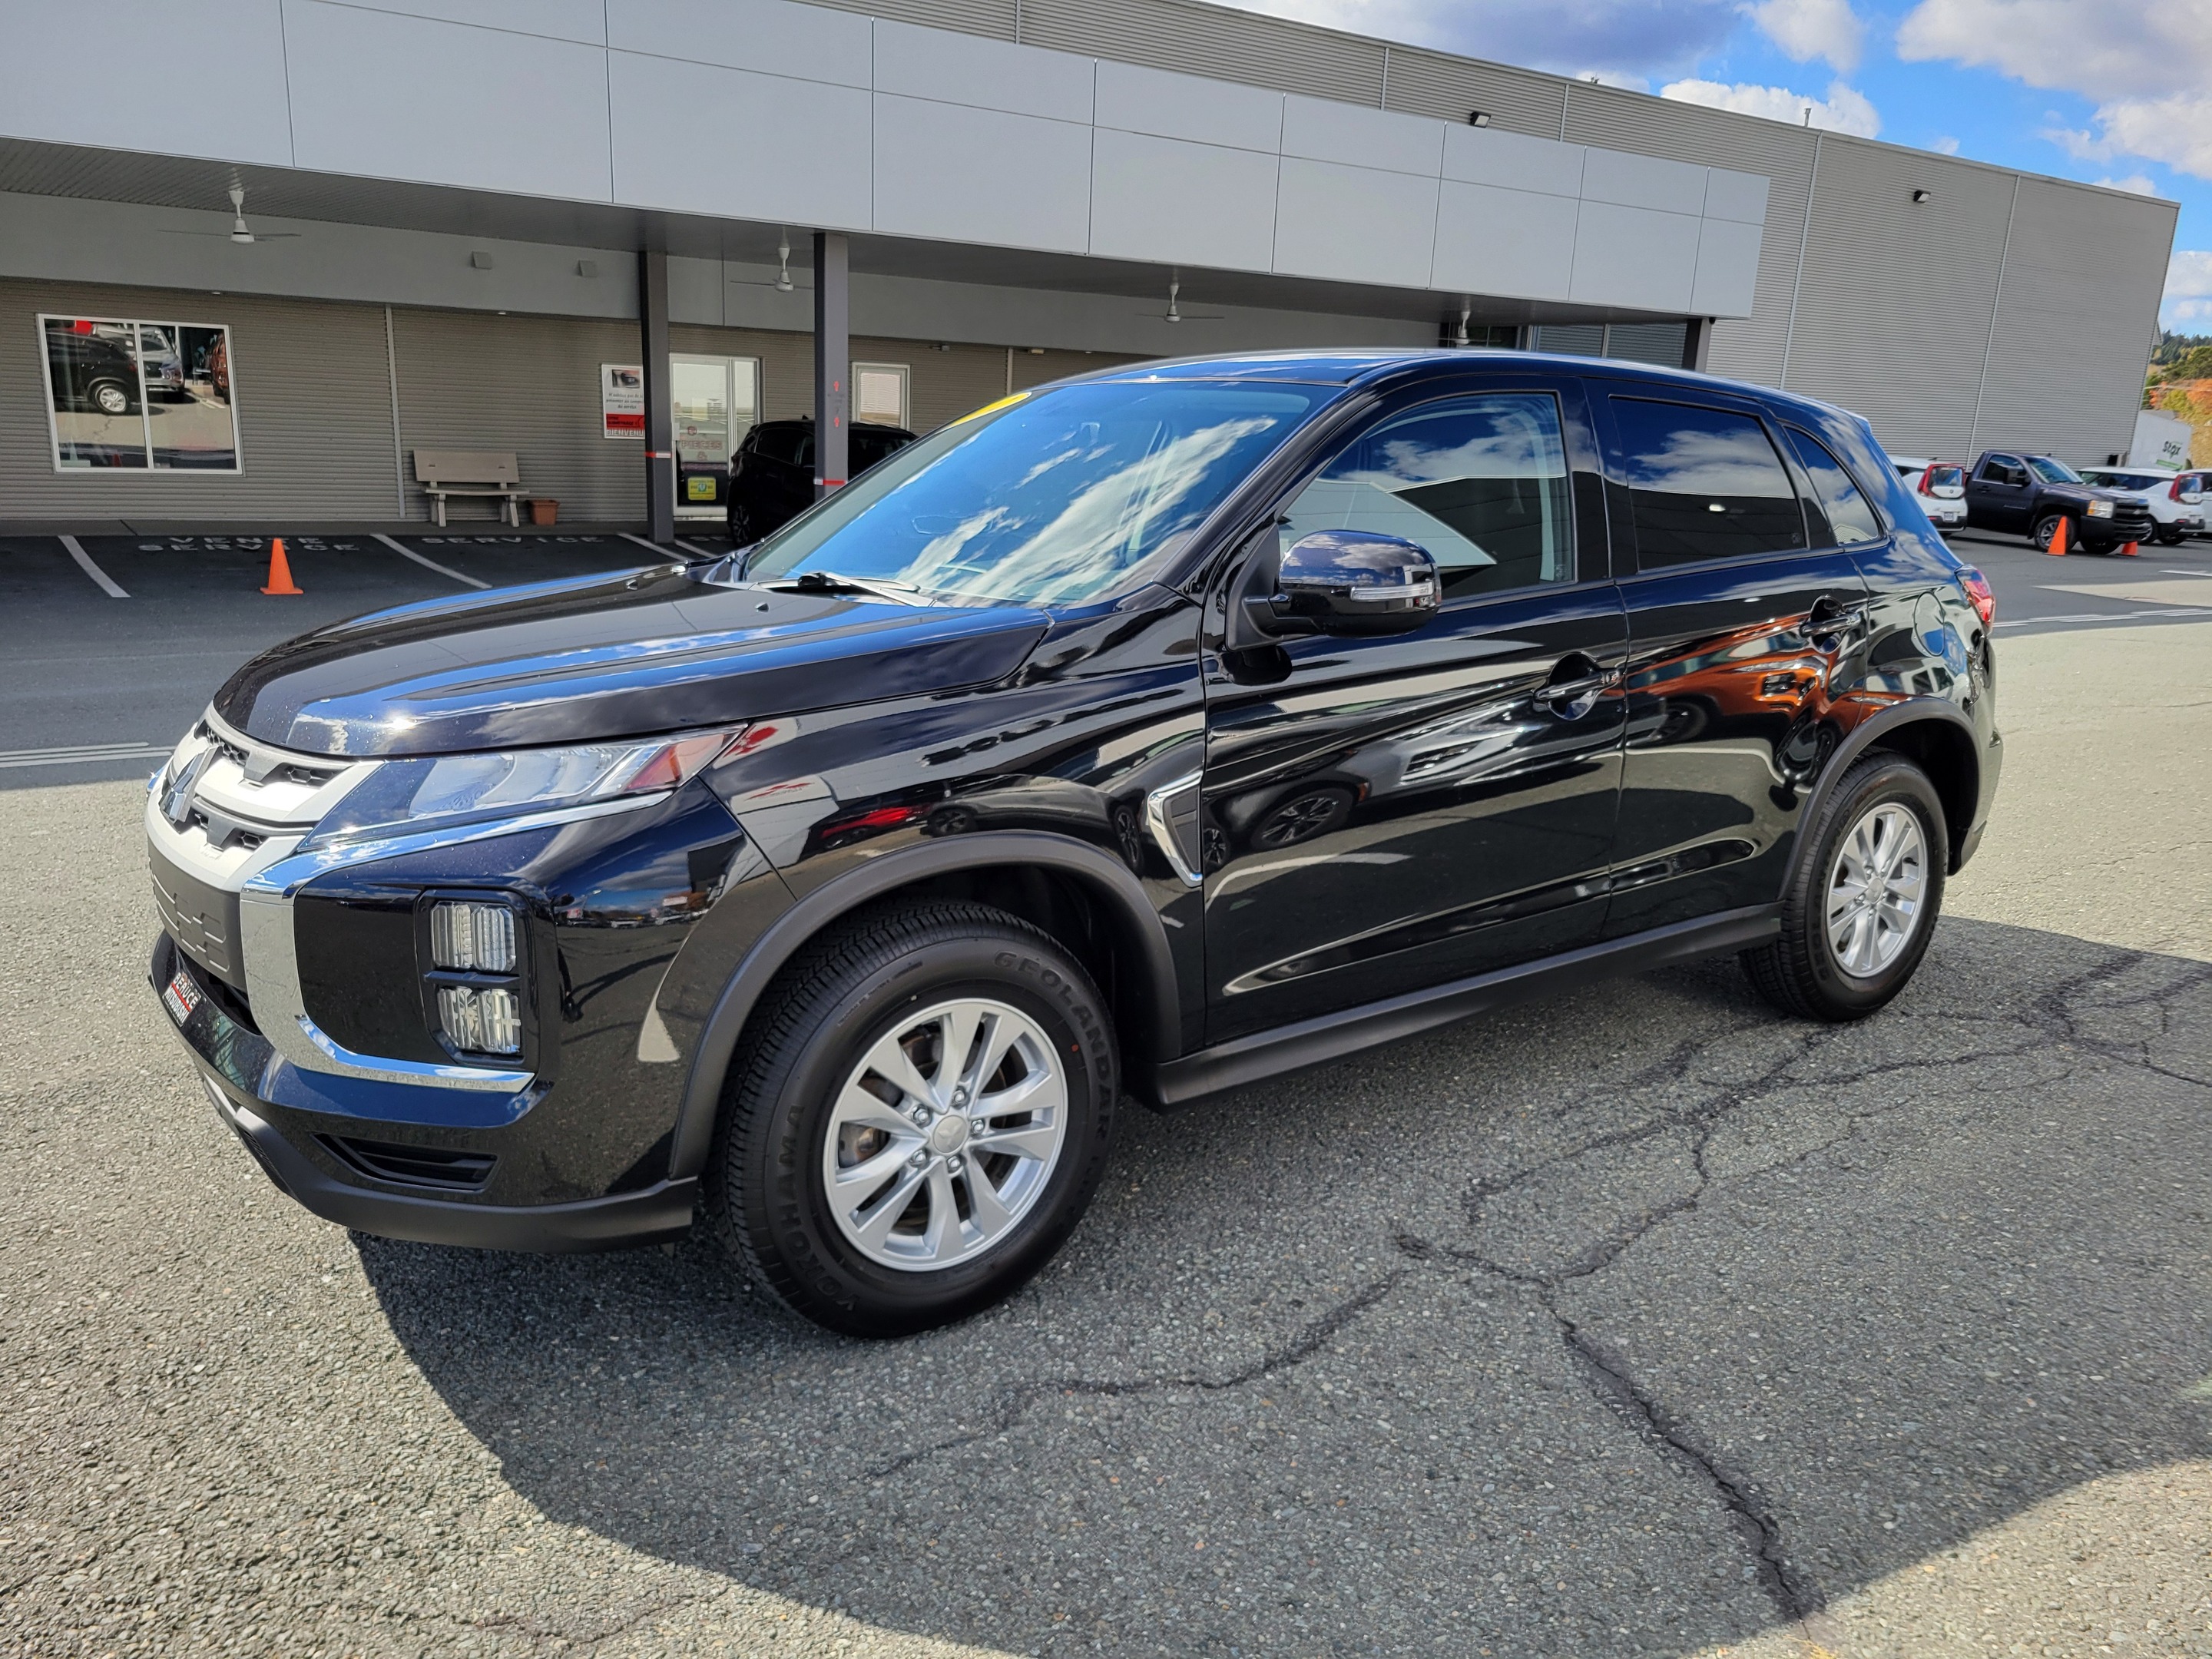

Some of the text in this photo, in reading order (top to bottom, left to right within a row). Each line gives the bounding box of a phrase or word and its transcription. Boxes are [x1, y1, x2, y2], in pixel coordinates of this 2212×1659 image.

[164, 984, 190, 1024] MITSUBISHI
[173, 972, 199, 1010] BEAUCE
[994, 950, 1112, 1141] GEOLANDAR
[777, 1104, 861, 1311] YOKOHAMA
